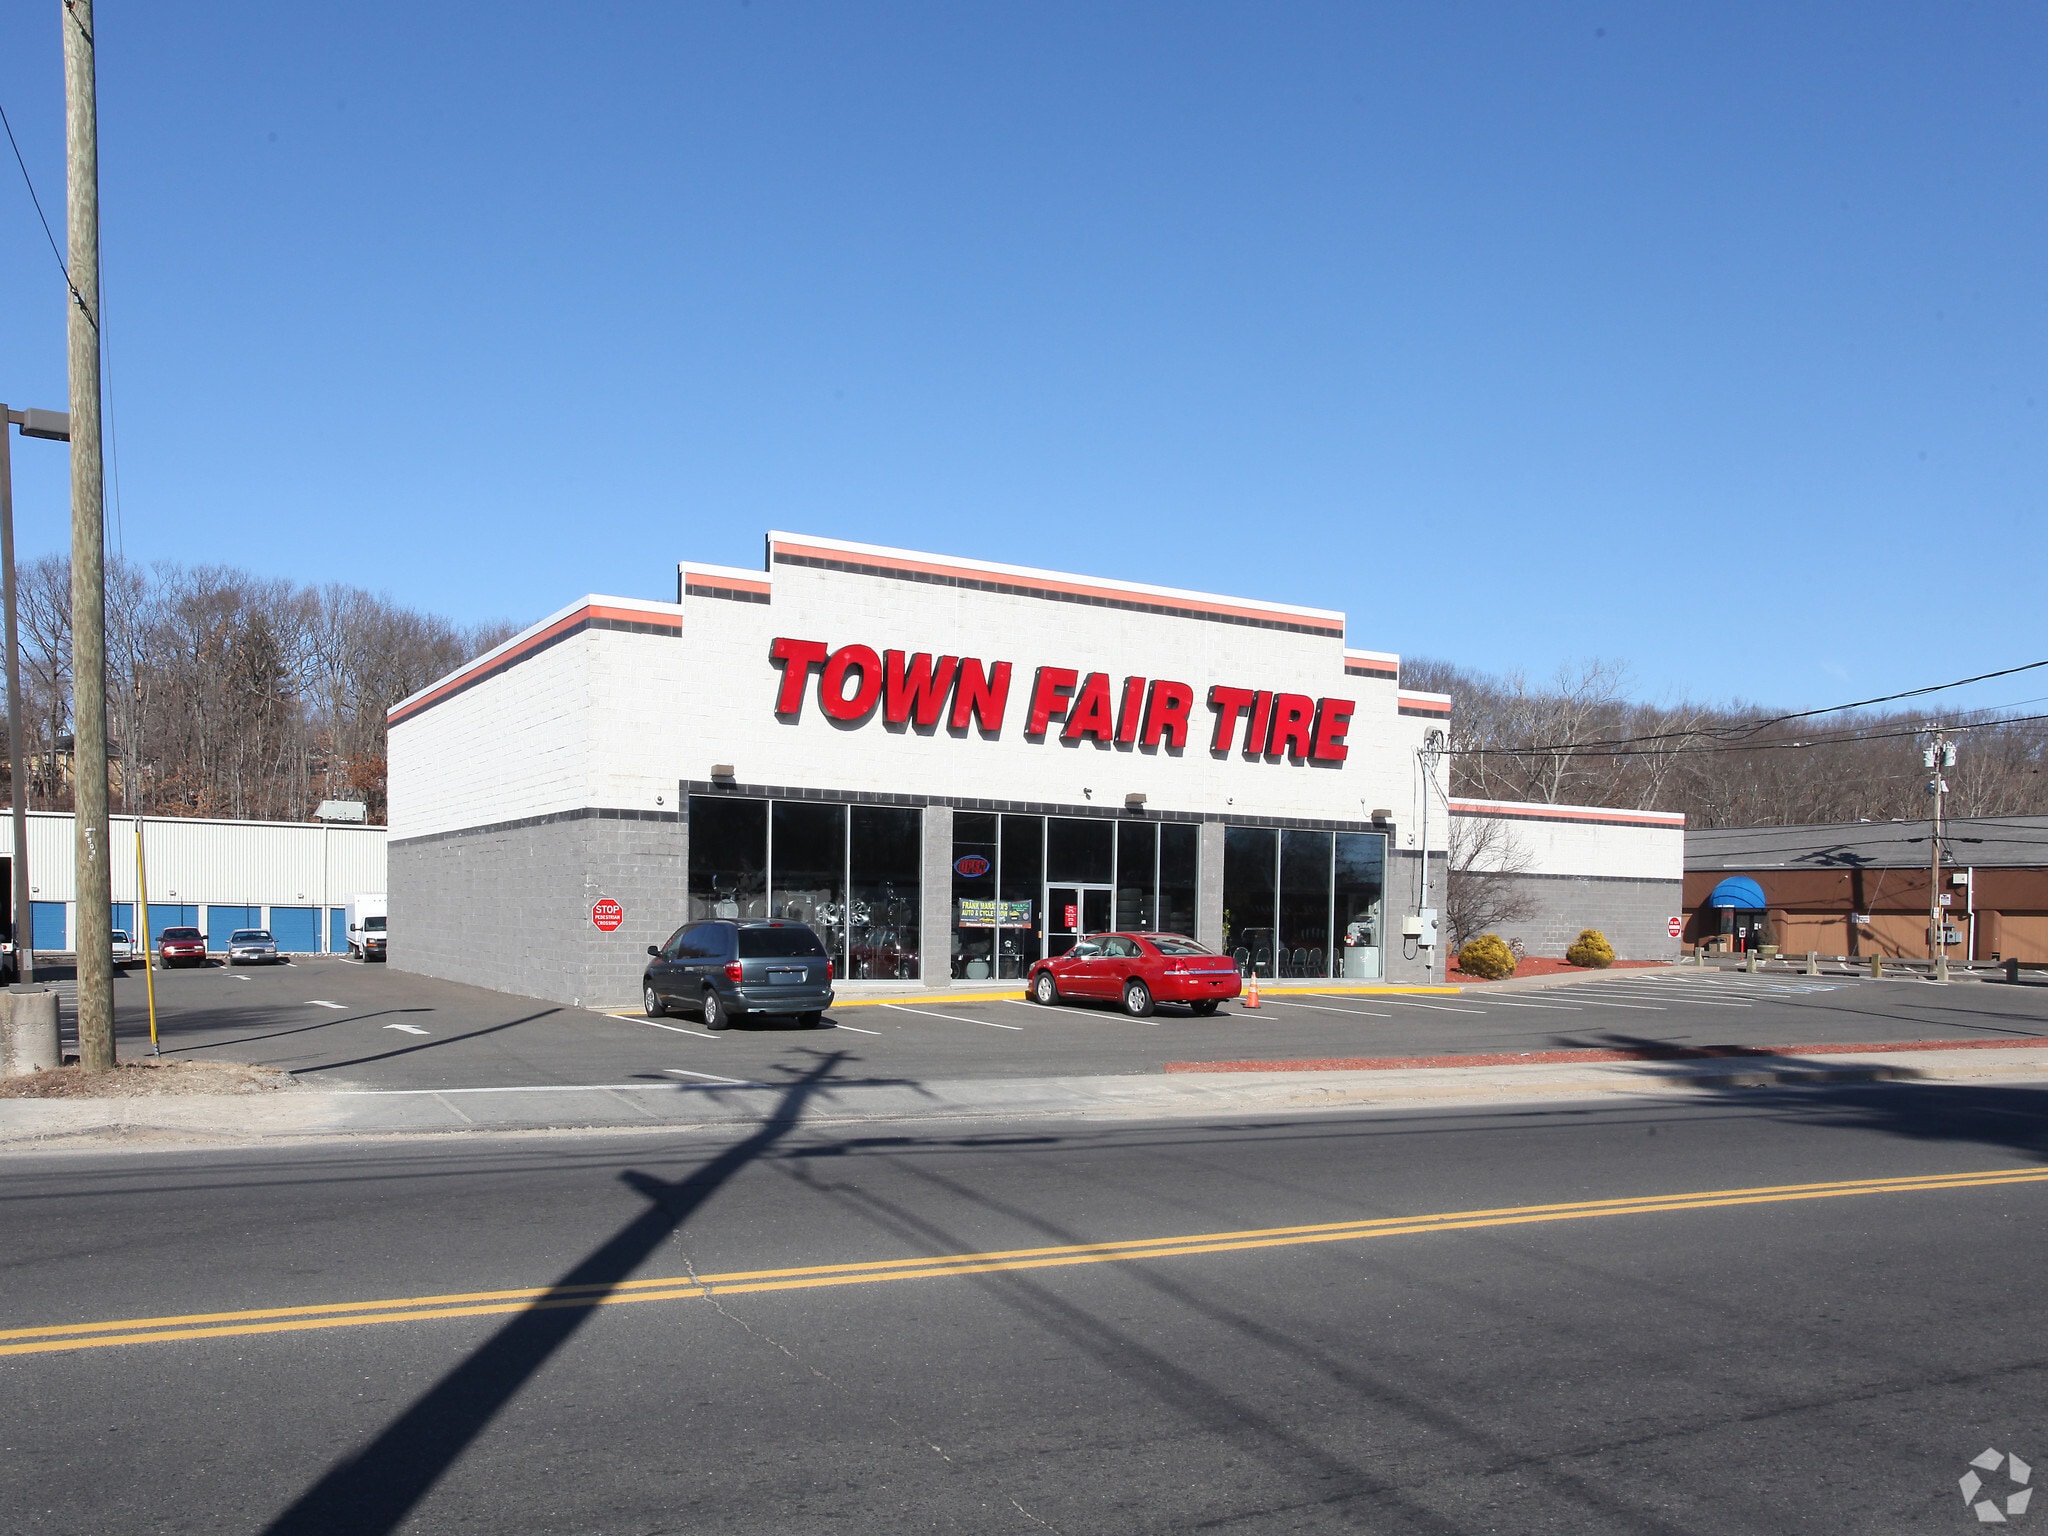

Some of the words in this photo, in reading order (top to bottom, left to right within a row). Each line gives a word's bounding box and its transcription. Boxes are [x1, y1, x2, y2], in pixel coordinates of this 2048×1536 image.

[769, 637, 1013, 741] TOWN
[1023, 666, 1194, 757] FAIR
[1207, 685, 1356, 769] TIRE
[596, 905, 619, 914] STOP
